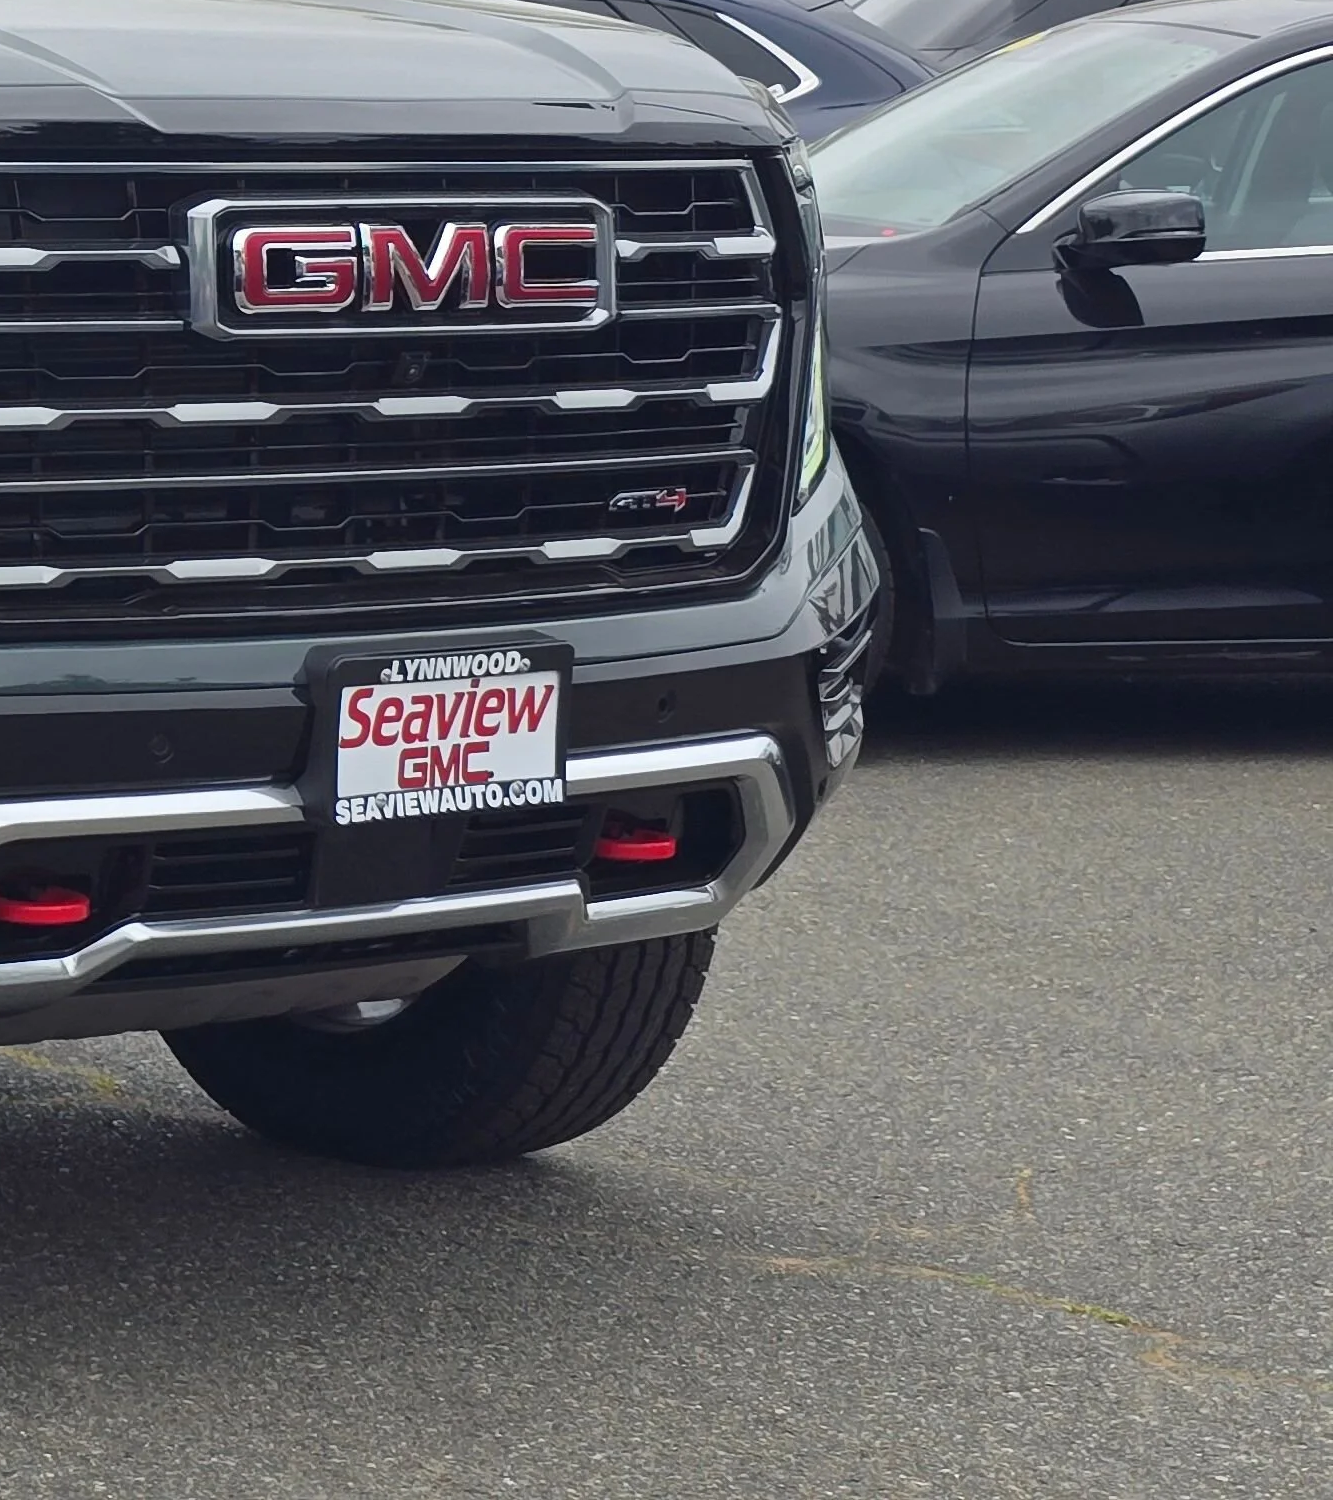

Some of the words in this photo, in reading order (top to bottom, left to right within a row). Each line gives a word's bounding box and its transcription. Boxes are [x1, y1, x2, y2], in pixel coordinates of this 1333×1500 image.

[233, 222, 600, 314] GMC
[389, 651, 521, 682] LYNNWOOD
[339, 678, 555, 749] Seaview
[397, 741, 493, 789] GMC
[335, 779, 564, 825] SEAVIEWAUTO.COM
